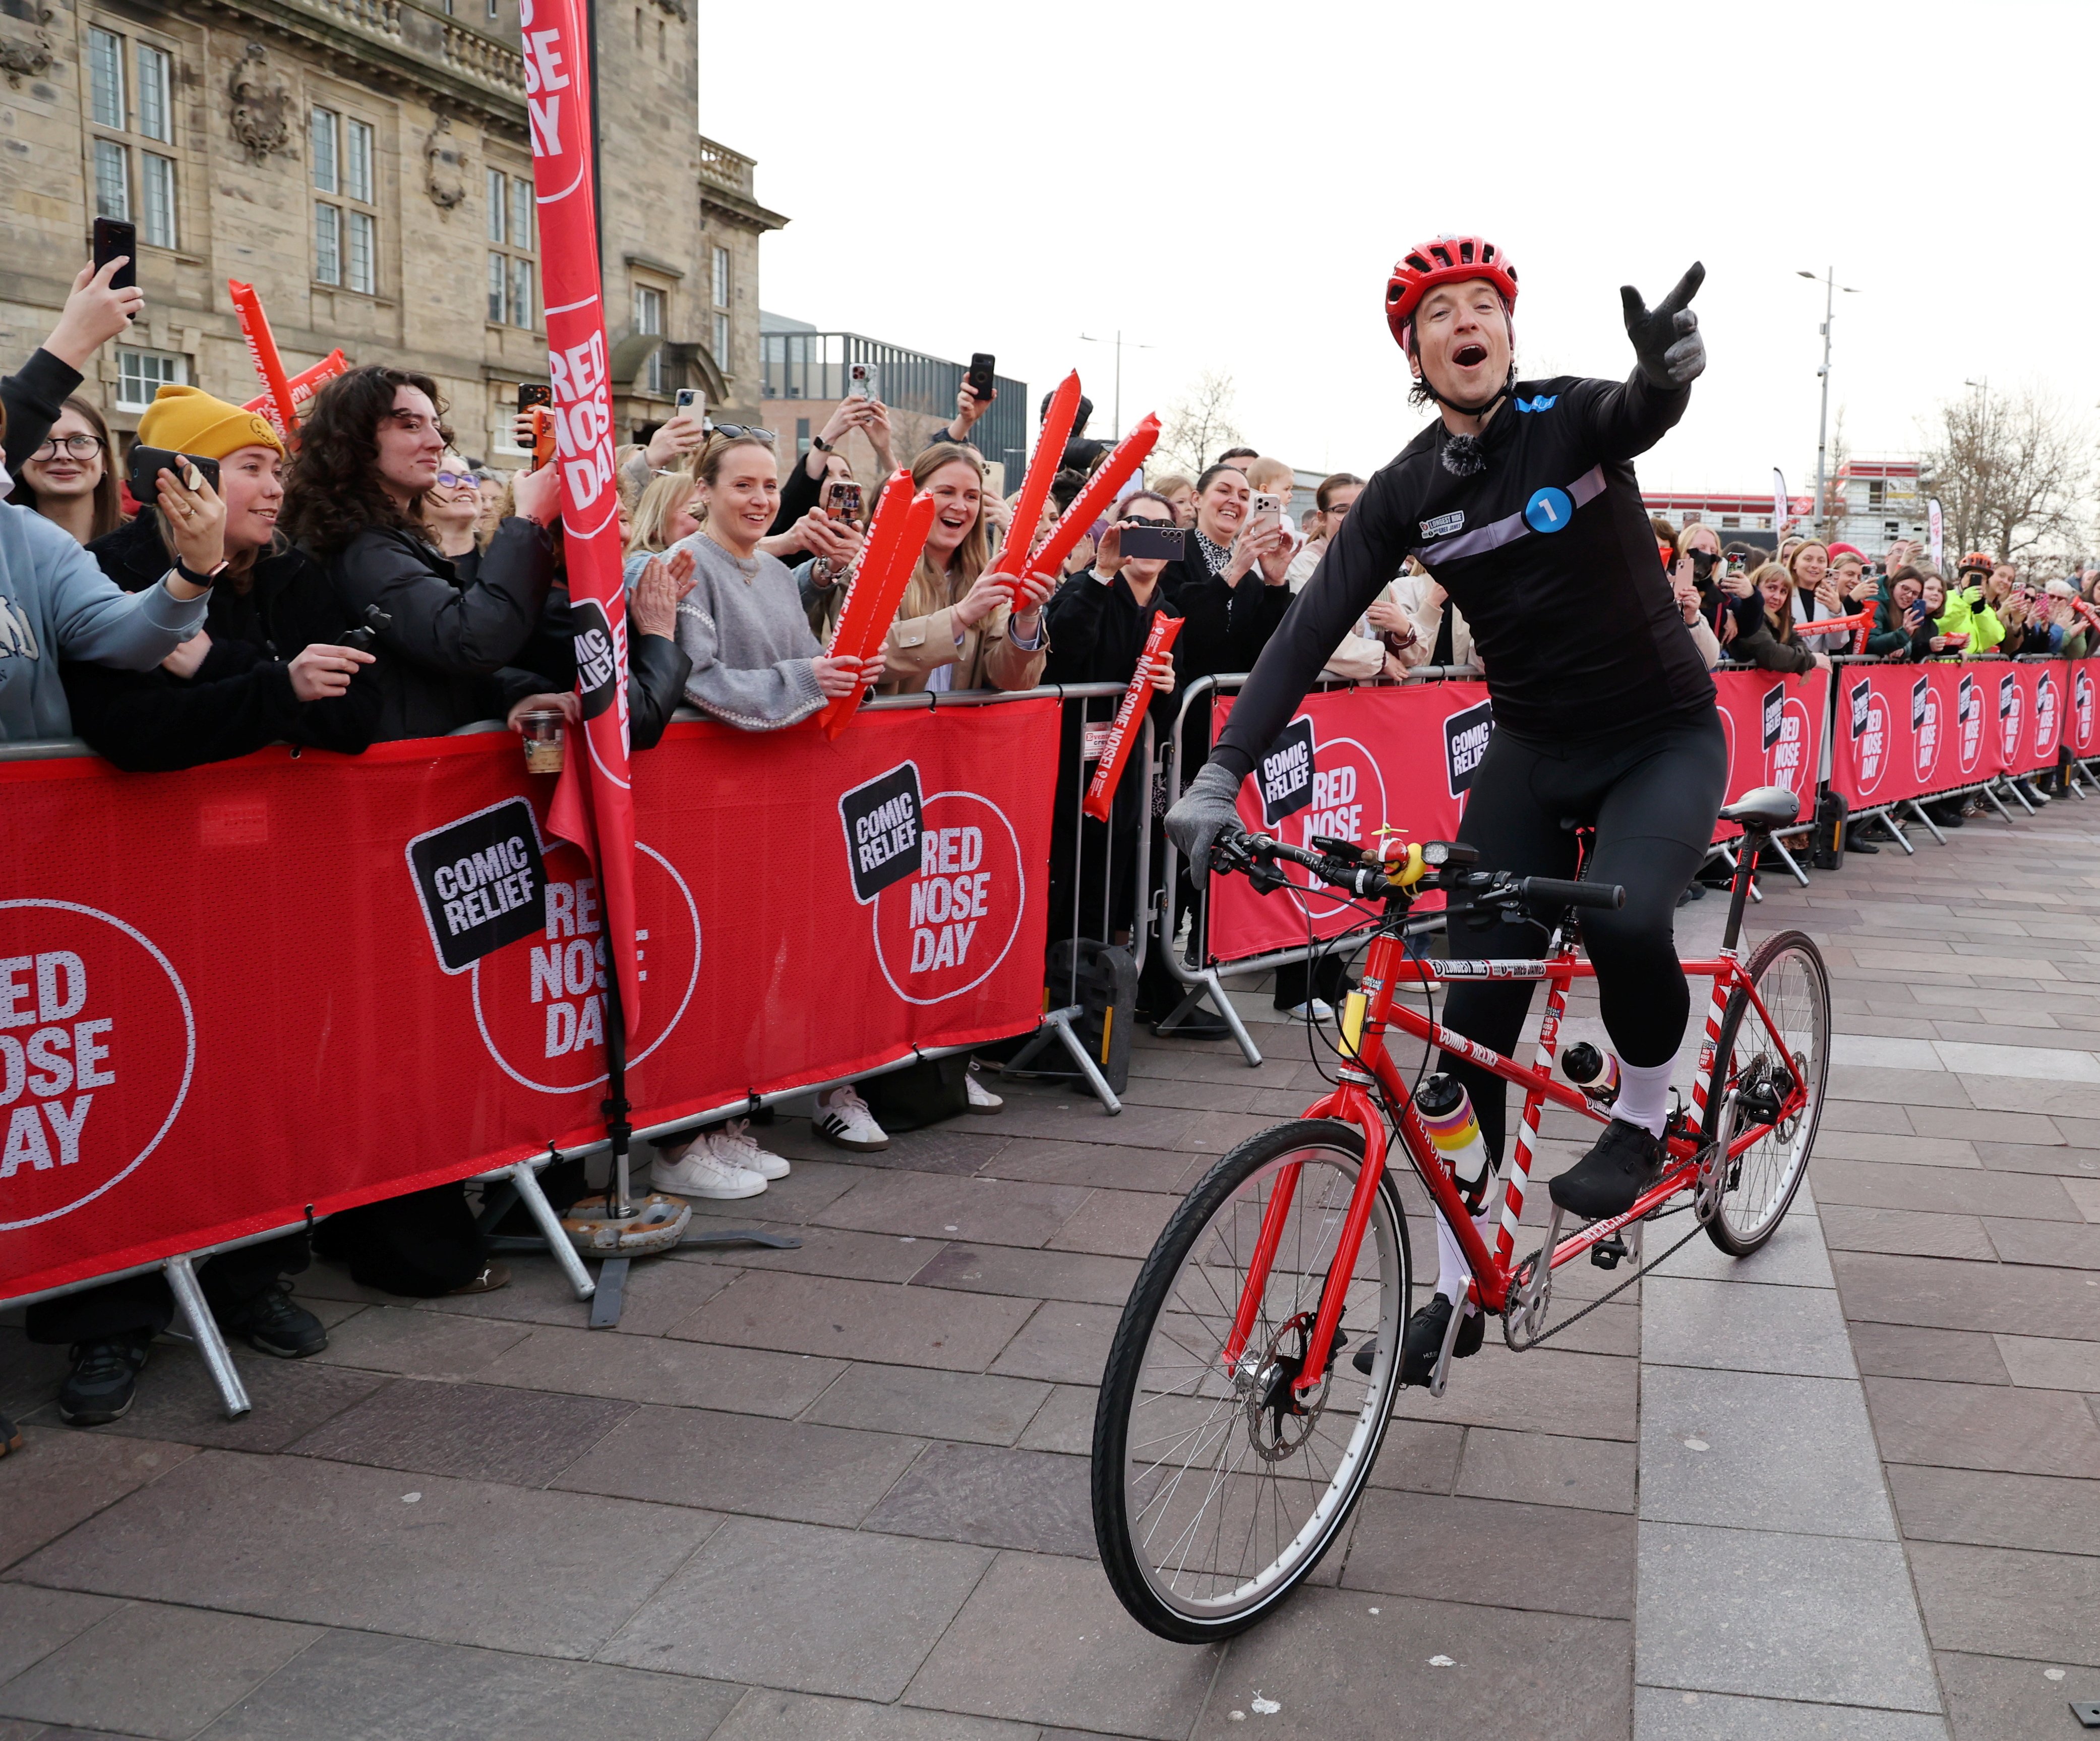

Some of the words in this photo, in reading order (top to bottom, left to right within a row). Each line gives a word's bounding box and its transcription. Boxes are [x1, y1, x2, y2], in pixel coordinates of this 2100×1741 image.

[522, 28, 570, 94] SE
[549, 329, 606, 403] RED
[291, 383, 313, 402] MA
[555, 384, 609, 458] NOS
[1088, 453, 1116, 491] MAKE
[1060, 488, 1088, 524] SOME
[1429, 516, 1451, 529] LONGEST
[1451, 513, 1462, 523] RIDE
[1538, 498, 1557, 522] 1
[860, 521, 877, 568] MAKE
[842, 569, 860, 614] SOME
[579, 647, 614, 693] LIEF
[1129, 655, 1154, 692] MAKE
[1114, 691, 1138, 728] SOME
[1765, 711, 1782, 737] RELIEF
[1766, 697, 1782, 722] COMIC
[1866, 709, 1882, 733] RED
[1086, 733, 1109, 741] Event
[1098, 727, 1125, 769] NOISE!
[1452, 722, 1489, 756] COMIC
[1779, 717, 1800, 742] RED
[1863, 732, 1883, 757] NOSE
[1264, 740, 1308, 781] COMIC
[1453, 741, 1489, 777] RELIE
[1774, 742, 1801, 770] NOSE
[1861, 755, 1880, 780] DAY
[1265, 762, 1309, 804] RELIEF
[1312, 766, 1356, 811] RED
[1775, 768, 1795, 790] DAY
[857, 792, 913, 844] COMIC
[1303, 804, 1362, 856] NOSE
[858, 819, 917, 873] RELIEF
[921, 826, 983, 877] RED
[434, 836, 528, 900] COMIC
[443, 868, 534, 936] RELIEF
[545, 878, 600, 940] RE
[910, 872, 991, 928] NOSE
[910, 921, 977, 973] DAY
[1446, 960, 1471, 974] LONGEST
[1472, 960, 1487, 974] RIDE
[1513, 963, 1527, 976] GREG
[1527, 963, 1545, 975] JAMES
[0, 951, 87, 1026] ED
[546, 994, 609, 1059] DA
[1439, 1025, 1468, 1053] COMIC
[0, 1018, 115, 1105] OSE
[1470, 1040, 1498, 1067] RELIEF
[0, 1094, 94, 1178] AY
[1579, 1212, 1632, 1243] MERCIAN
